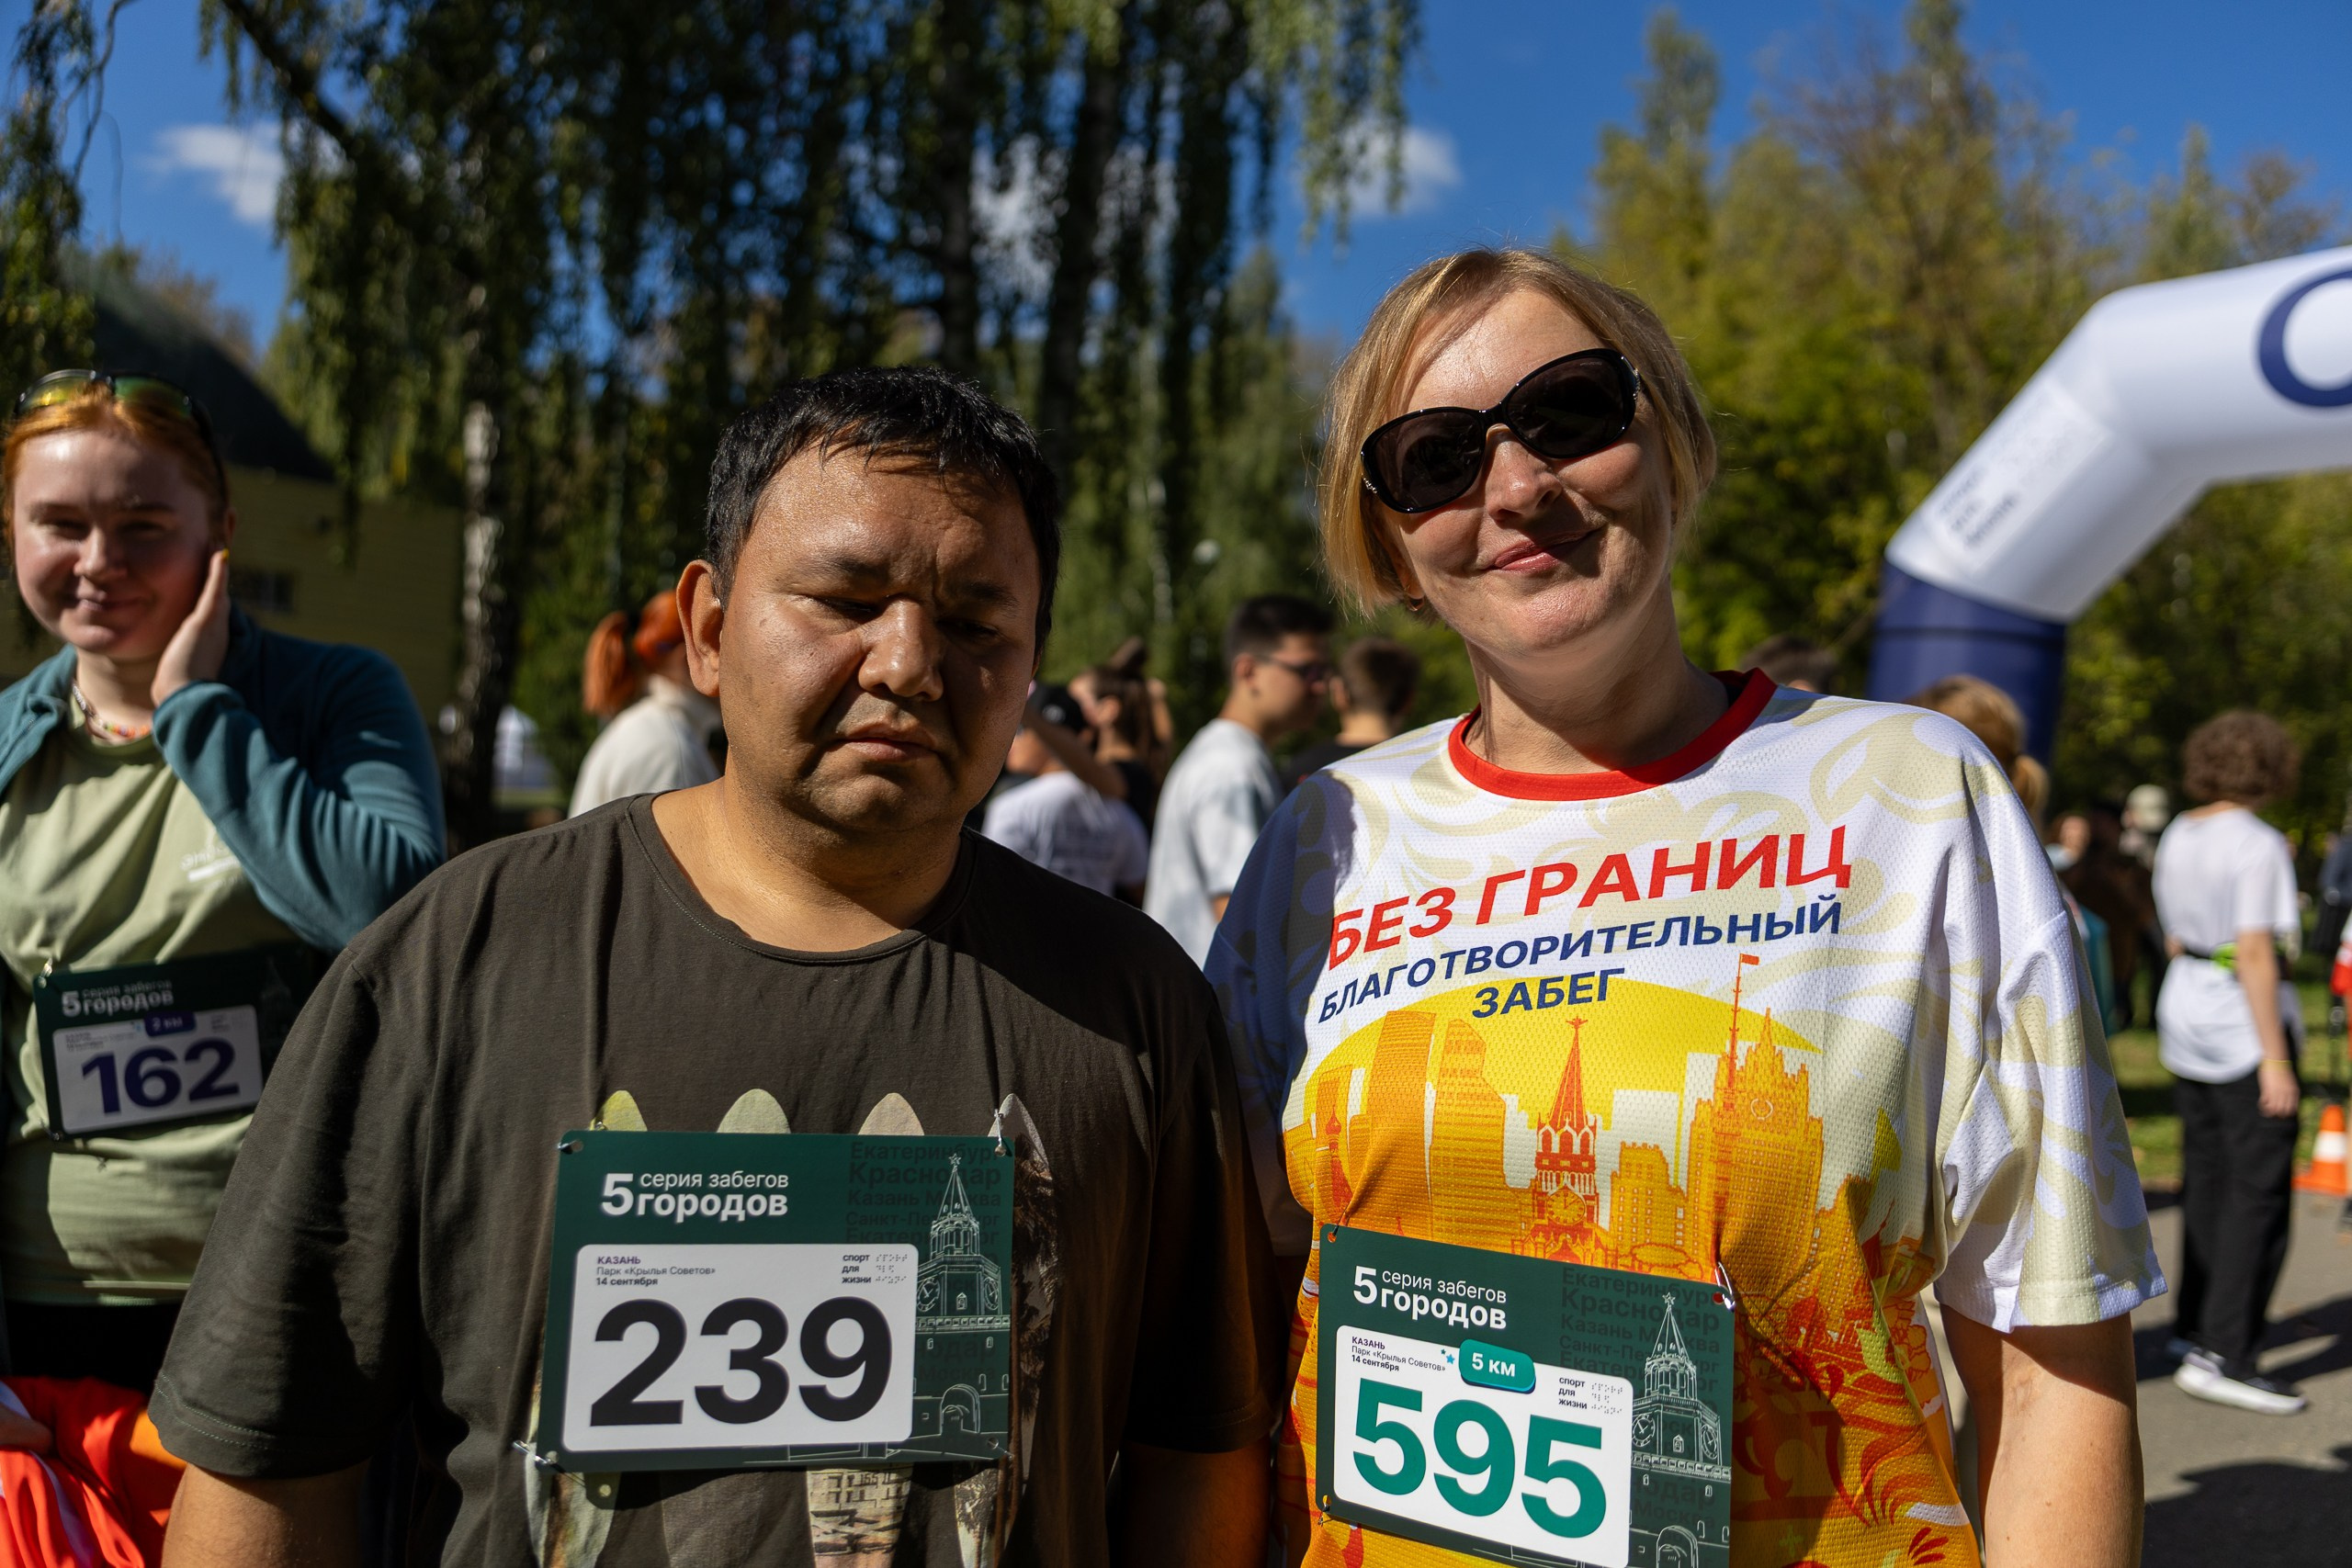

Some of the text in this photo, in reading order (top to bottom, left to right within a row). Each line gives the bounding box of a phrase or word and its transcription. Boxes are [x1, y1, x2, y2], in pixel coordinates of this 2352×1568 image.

[1328, 825, 1853, 970] БЕЗ ГРАНИЦ
[1318, 894, 1842, 1023] БЛАГОТВОРИТЕЛЬНЫЙ
[62, 989, 174, 1017] 5 городов
[1471, 968, 1625, 1019] ЗАБЕГ
[82, 1038, 241, 1116] 162
[851, 1142, 999, 1164] Екатеринбур
[640, 1170, 789, 1191] серия забегов
[601, 1172, 788, 1223] 5 городов
[597, 1256, 641, 1265] КАЗАНЬ
[842, 1254, 870, 1263] спорт
[596, 1266, 716, 1277] Парк «Крылья Советов»
[842, 1266, 860, 1274] для
[842, 1276, 872, 1284] жизни
[610, 1277, 659, 1287] сентября
[1382, 1268, 1507, 1304] серия забегов
[1353, 1265, 1507, 1329] 5 городов
[1351, 1336, 1385, 1349] КАЗАНЬ
[590, 1296, 892, 1427] 239
[1351, 1346, 1446, 1371] Парк «Крылья Советов»
[1351, 1354, 1399, 1371] 14 сентября
[1472, 1352, 1516, 1377] 5 км
[1558, 1388, 1576, 1397] для
[1559, 1377, 1586, 1388] спорт
[1558, 1398, 1588, 1410] жизни
[1353, 1378, 1607, 1539] 595
